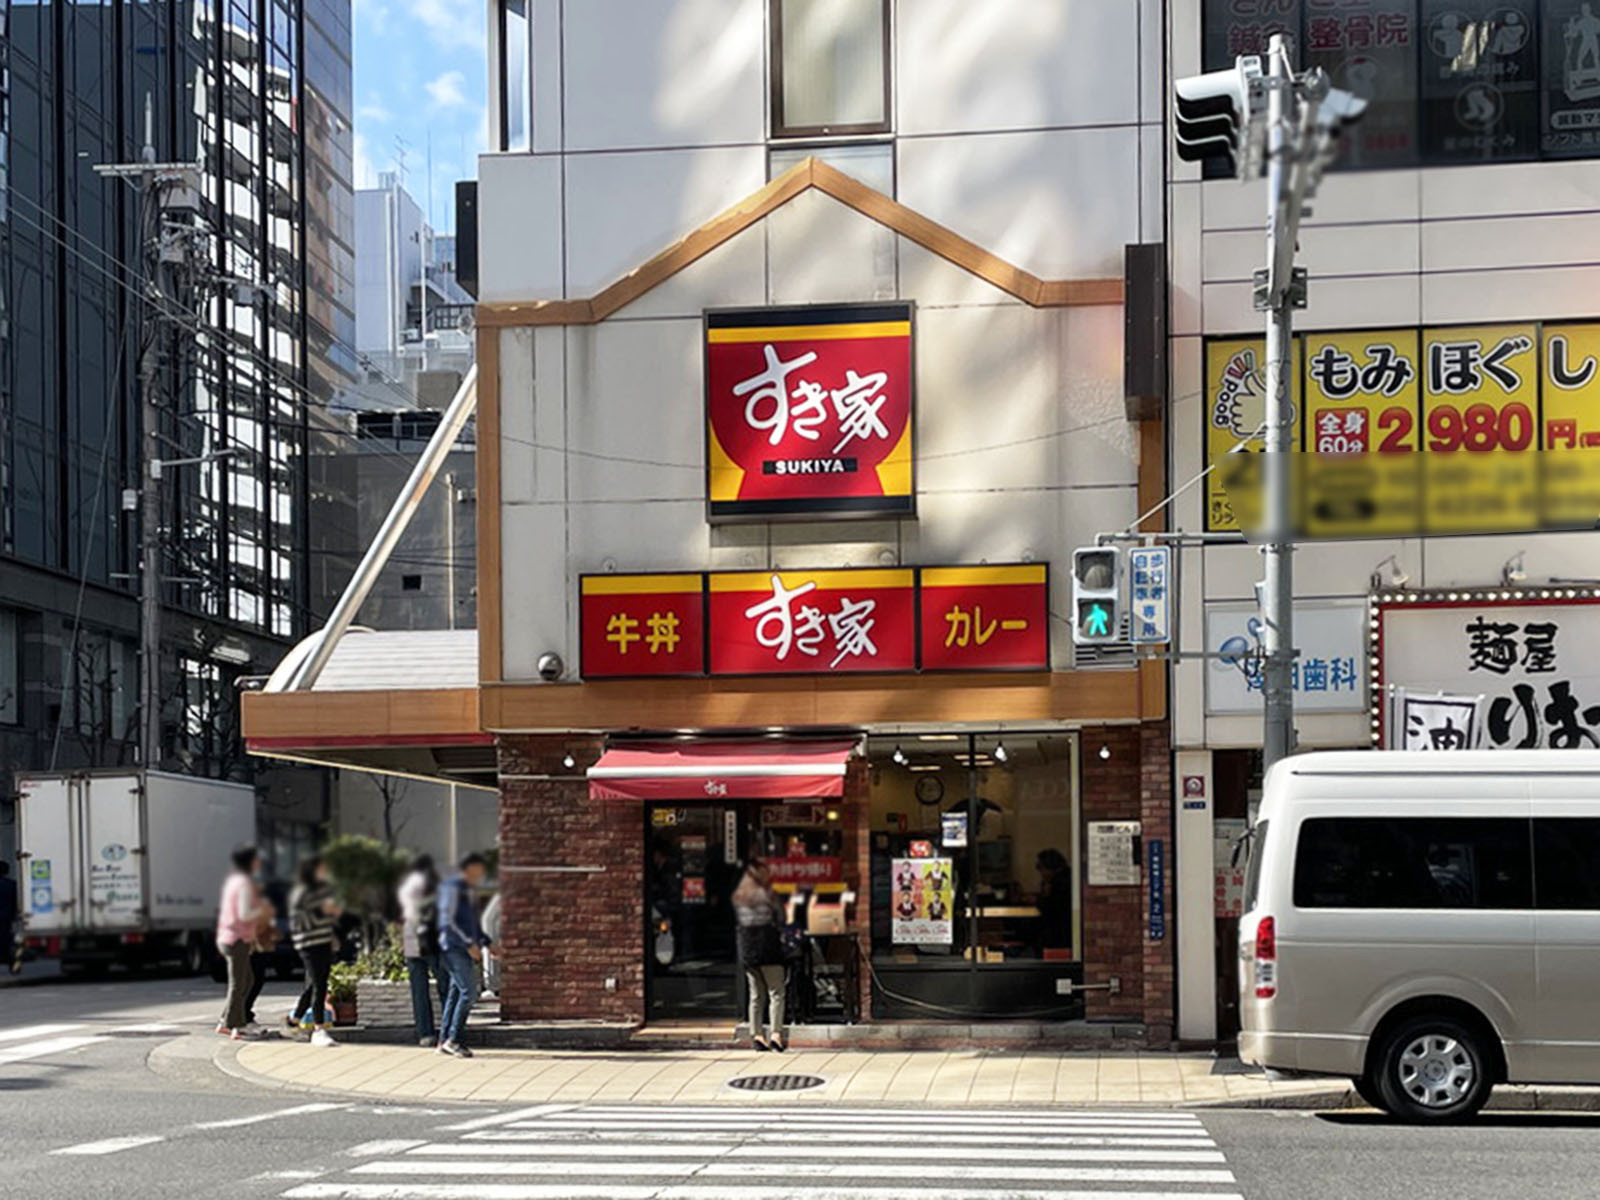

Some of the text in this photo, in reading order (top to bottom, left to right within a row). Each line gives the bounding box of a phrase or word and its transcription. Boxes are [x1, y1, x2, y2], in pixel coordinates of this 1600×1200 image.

[732, 343, 890, 454] すき家
[1319, 413, 1367, 436] 全身
[775, 458, 845, 474] SUKIYA
[606, 611, 681, 655] 牛丼
[744, 574, 878, 669] すき家
[944, 604, 1028, 649] カレー
